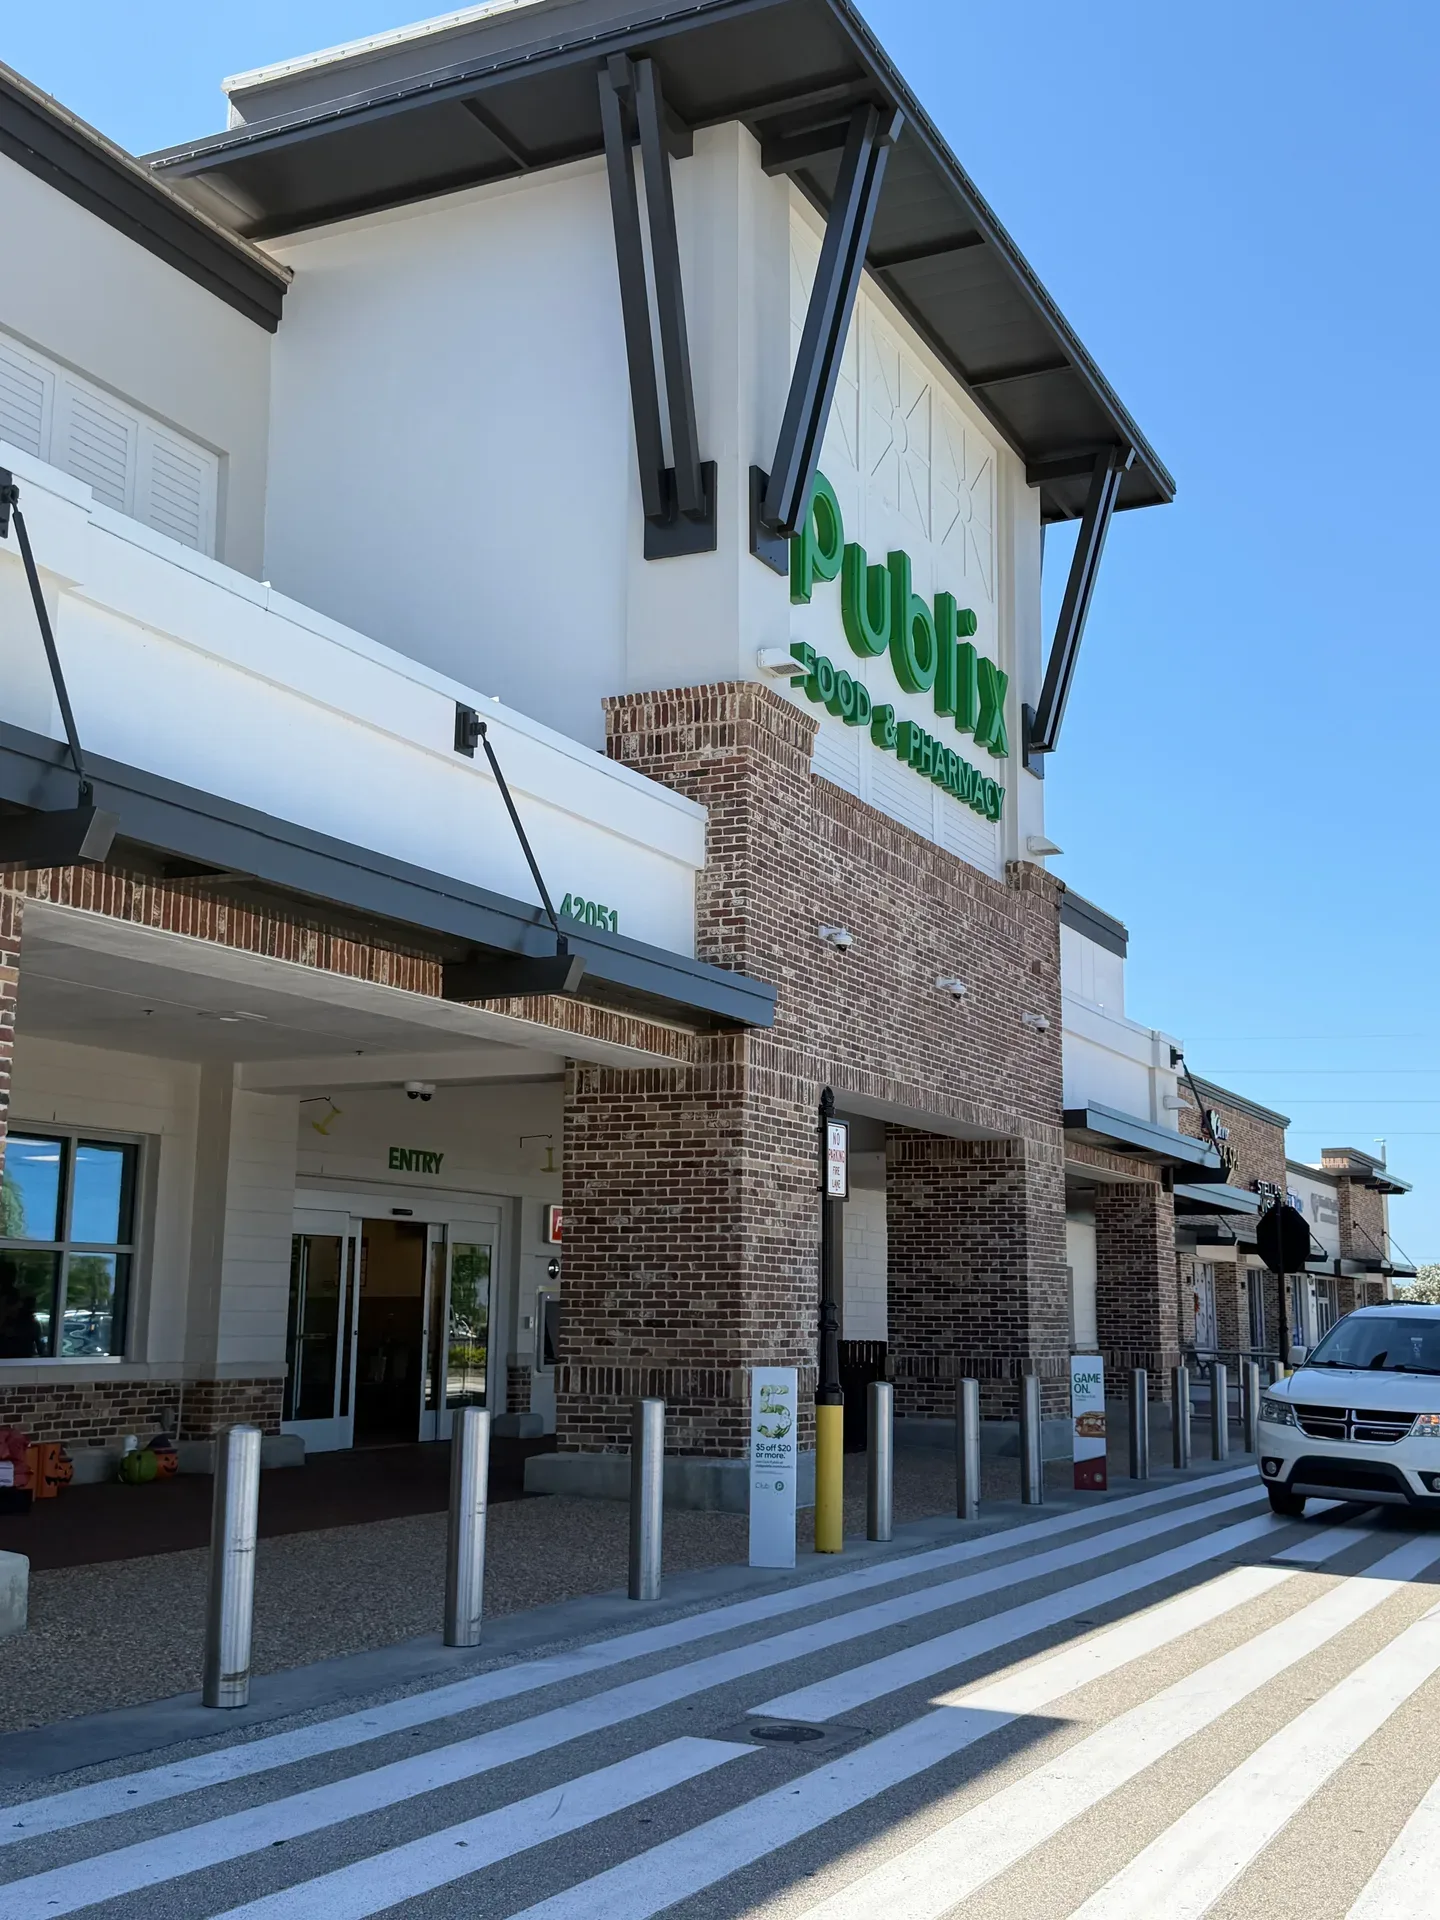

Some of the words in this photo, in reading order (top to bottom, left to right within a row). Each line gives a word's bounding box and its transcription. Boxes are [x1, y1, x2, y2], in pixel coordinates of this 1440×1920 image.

[790, 642, 871, 727] FOOD
[871, 703, 897, 751] &
[897, 720, 1006, 823] PHARMACY
[560, 893, 618, 933] 42051
[832, 1132, 841, 1146] NO
[388, 1146, 444, 1174] ENTRY
[828, 1148, 845, 1163] PARKING
[832, 1165, 841, 1176] FIRE
[831, 1179, 841, 1189] LANE
[1073, 1372, 1101, 1384] GAME
[1073, 1383, 1091, 1394] ON.
[755, 1443, 765, 1452] $5
[765, 1443, 777, 1452] off
[777, 1444, 792, 1452] $20
